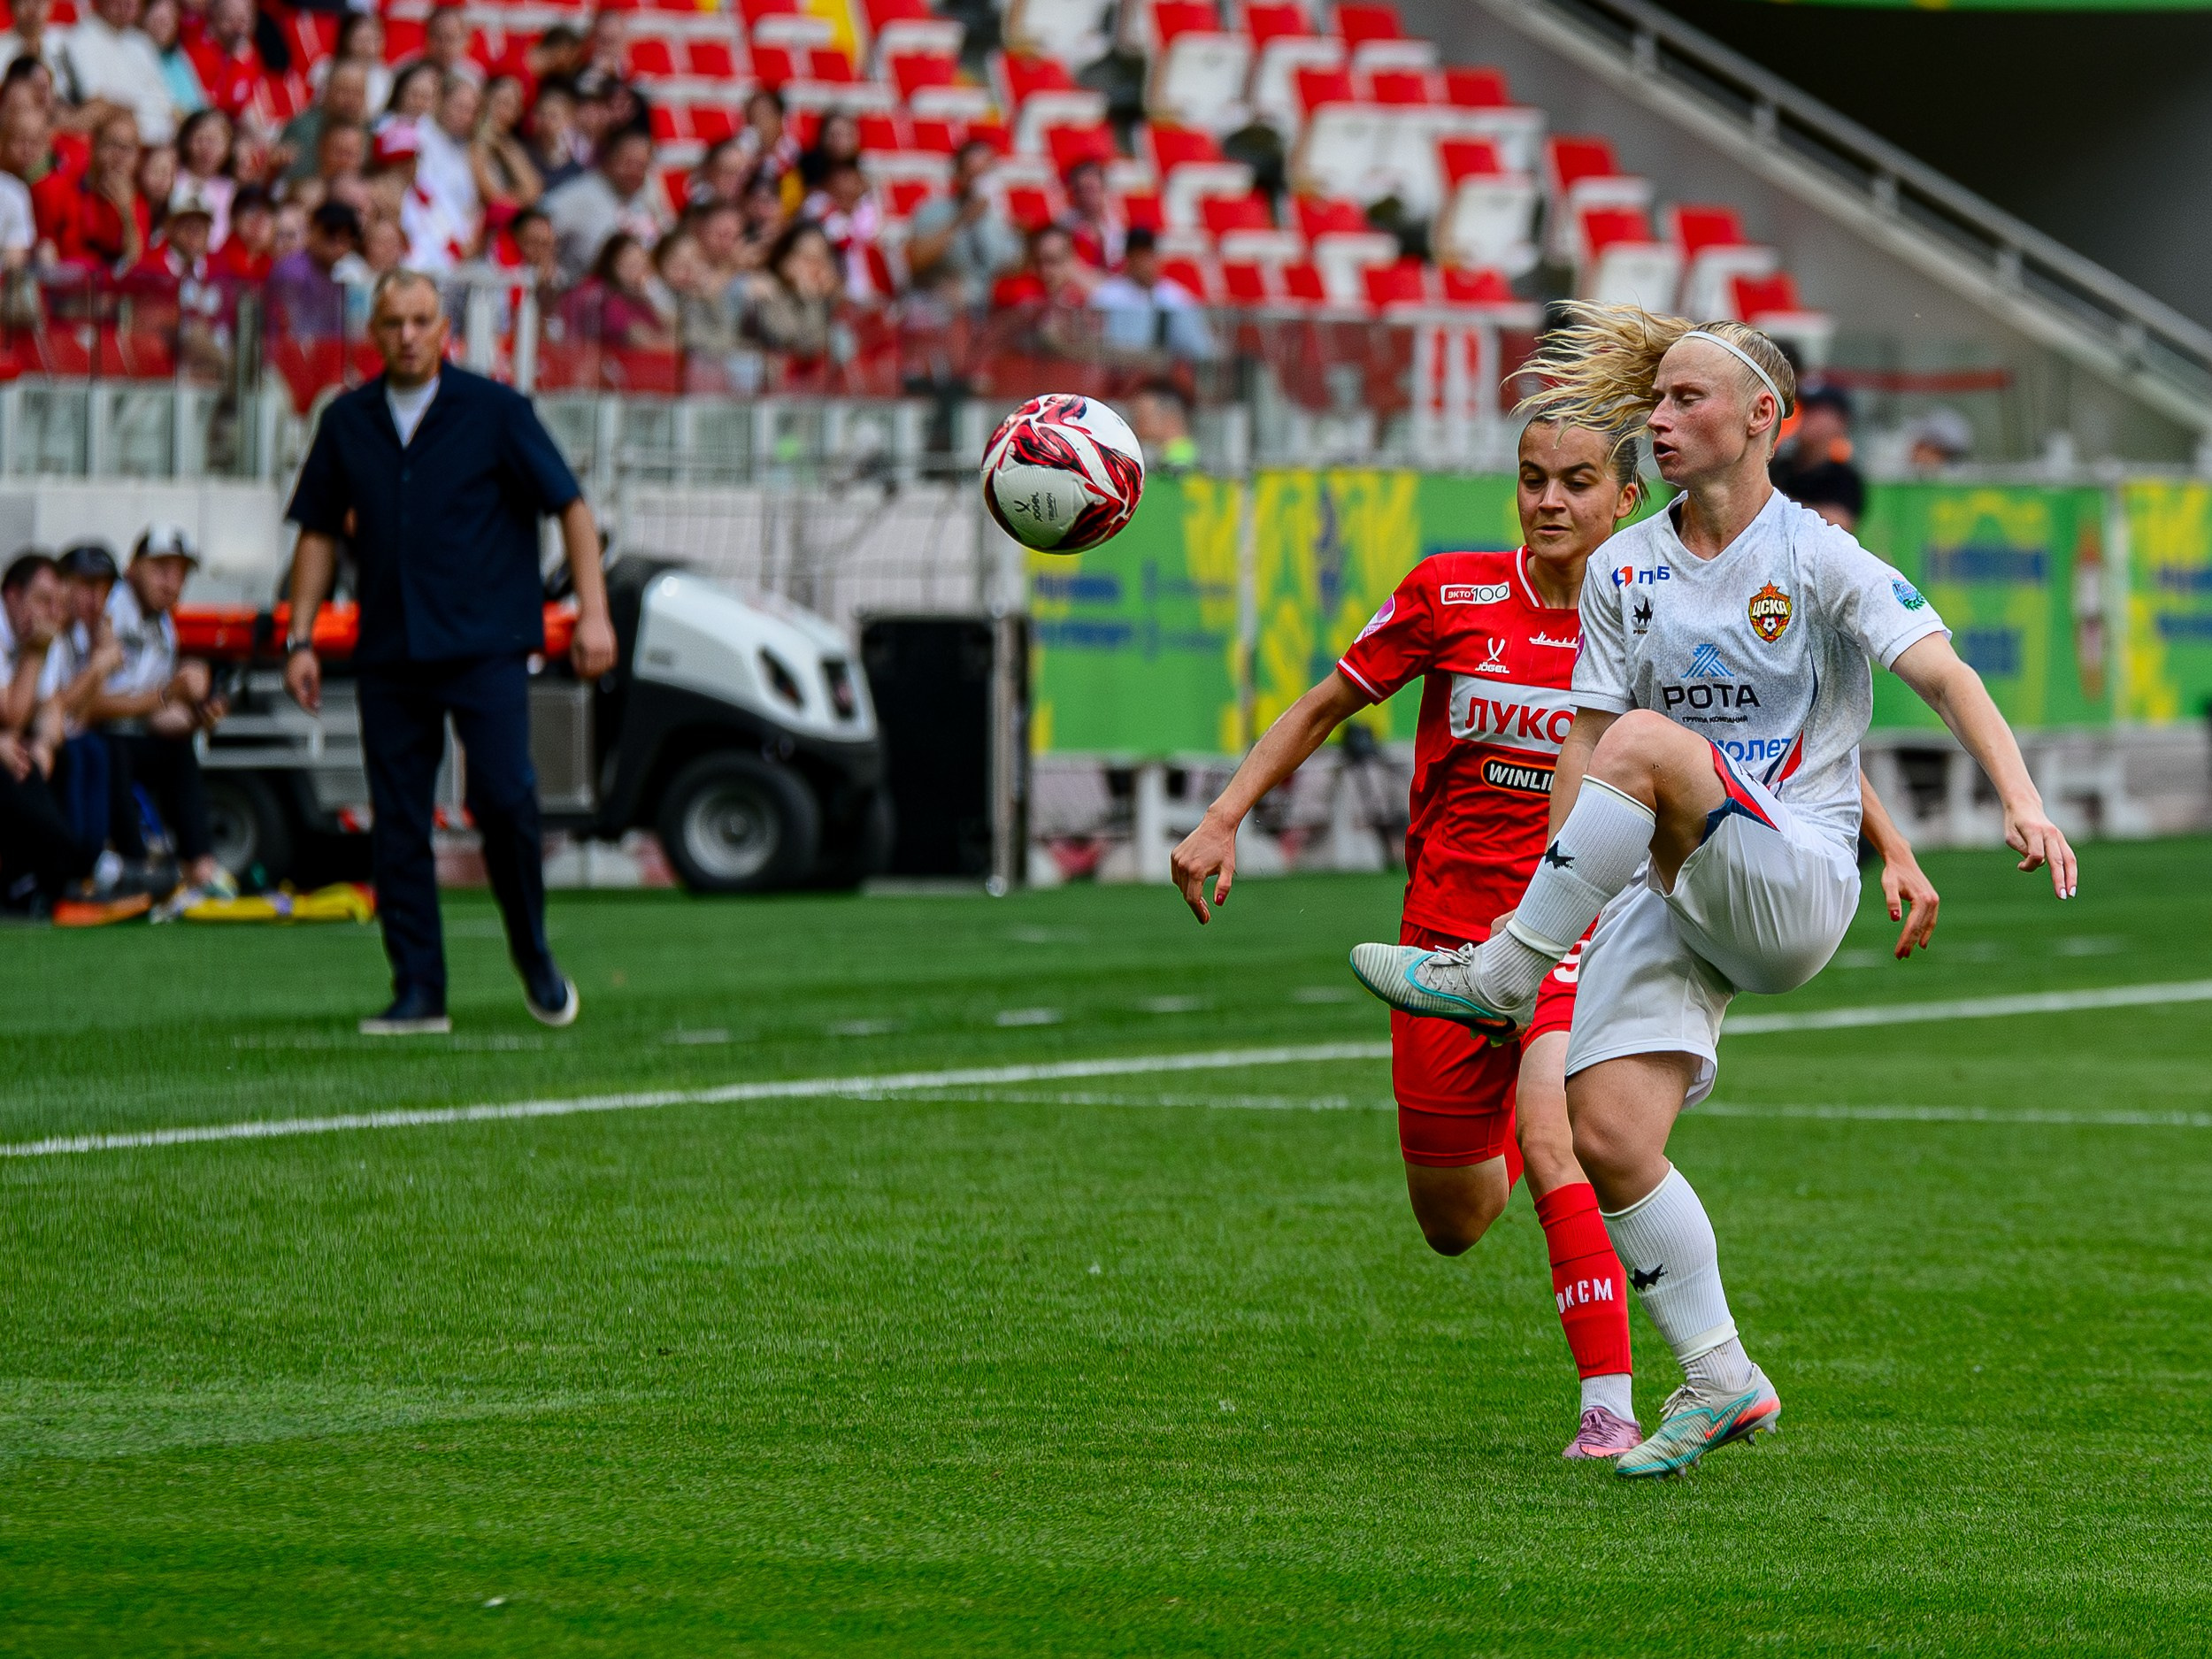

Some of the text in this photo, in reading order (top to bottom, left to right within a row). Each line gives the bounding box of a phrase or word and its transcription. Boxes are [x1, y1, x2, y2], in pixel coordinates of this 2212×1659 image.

[1752, 599, 1788, 618] ЦСКА
[1662, 683, 1762, 710] РОТА
[1464, 696, 1576, 745] ЛУКО
[1682, 716, 1709, 725] ГРУППА
